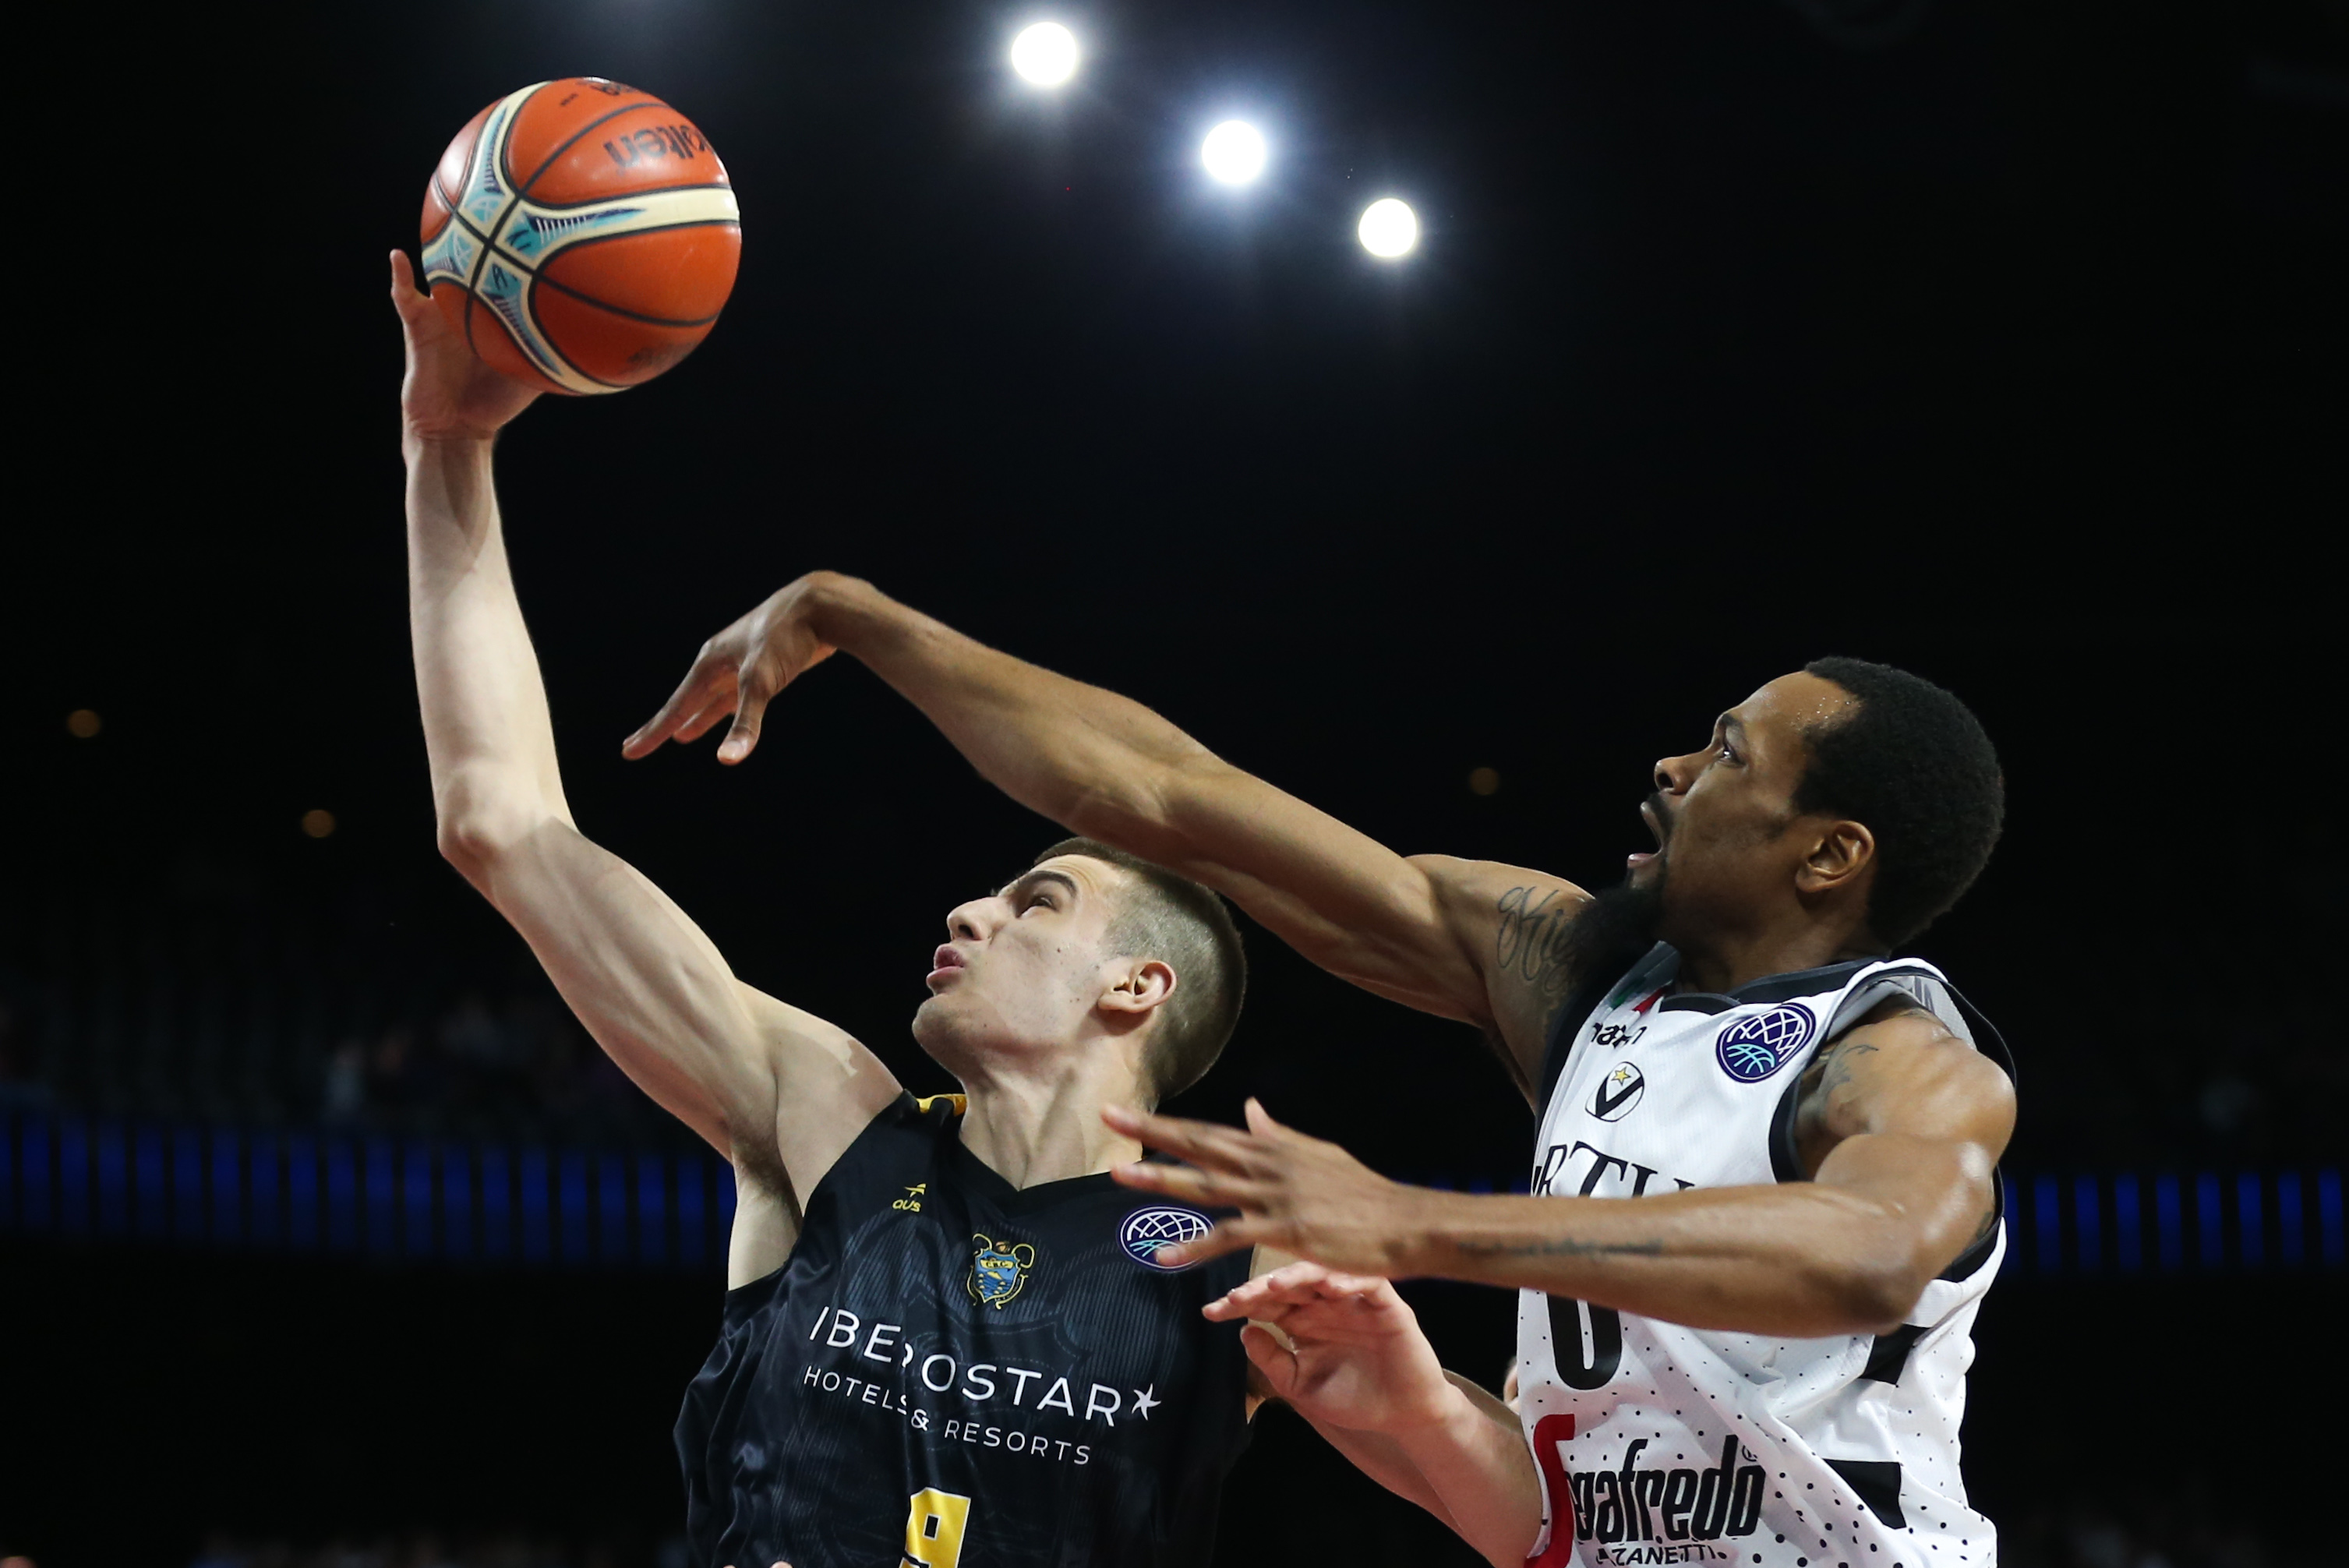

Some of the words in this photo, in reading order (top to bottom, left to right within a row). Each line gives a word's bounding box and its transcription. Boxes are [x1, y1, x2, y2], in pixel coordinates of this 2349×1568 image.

[603, 125, 708, 169] olten
[910, 1408, 930, 1432] &
[944, 1419, 1091, 1465] RESORTS
